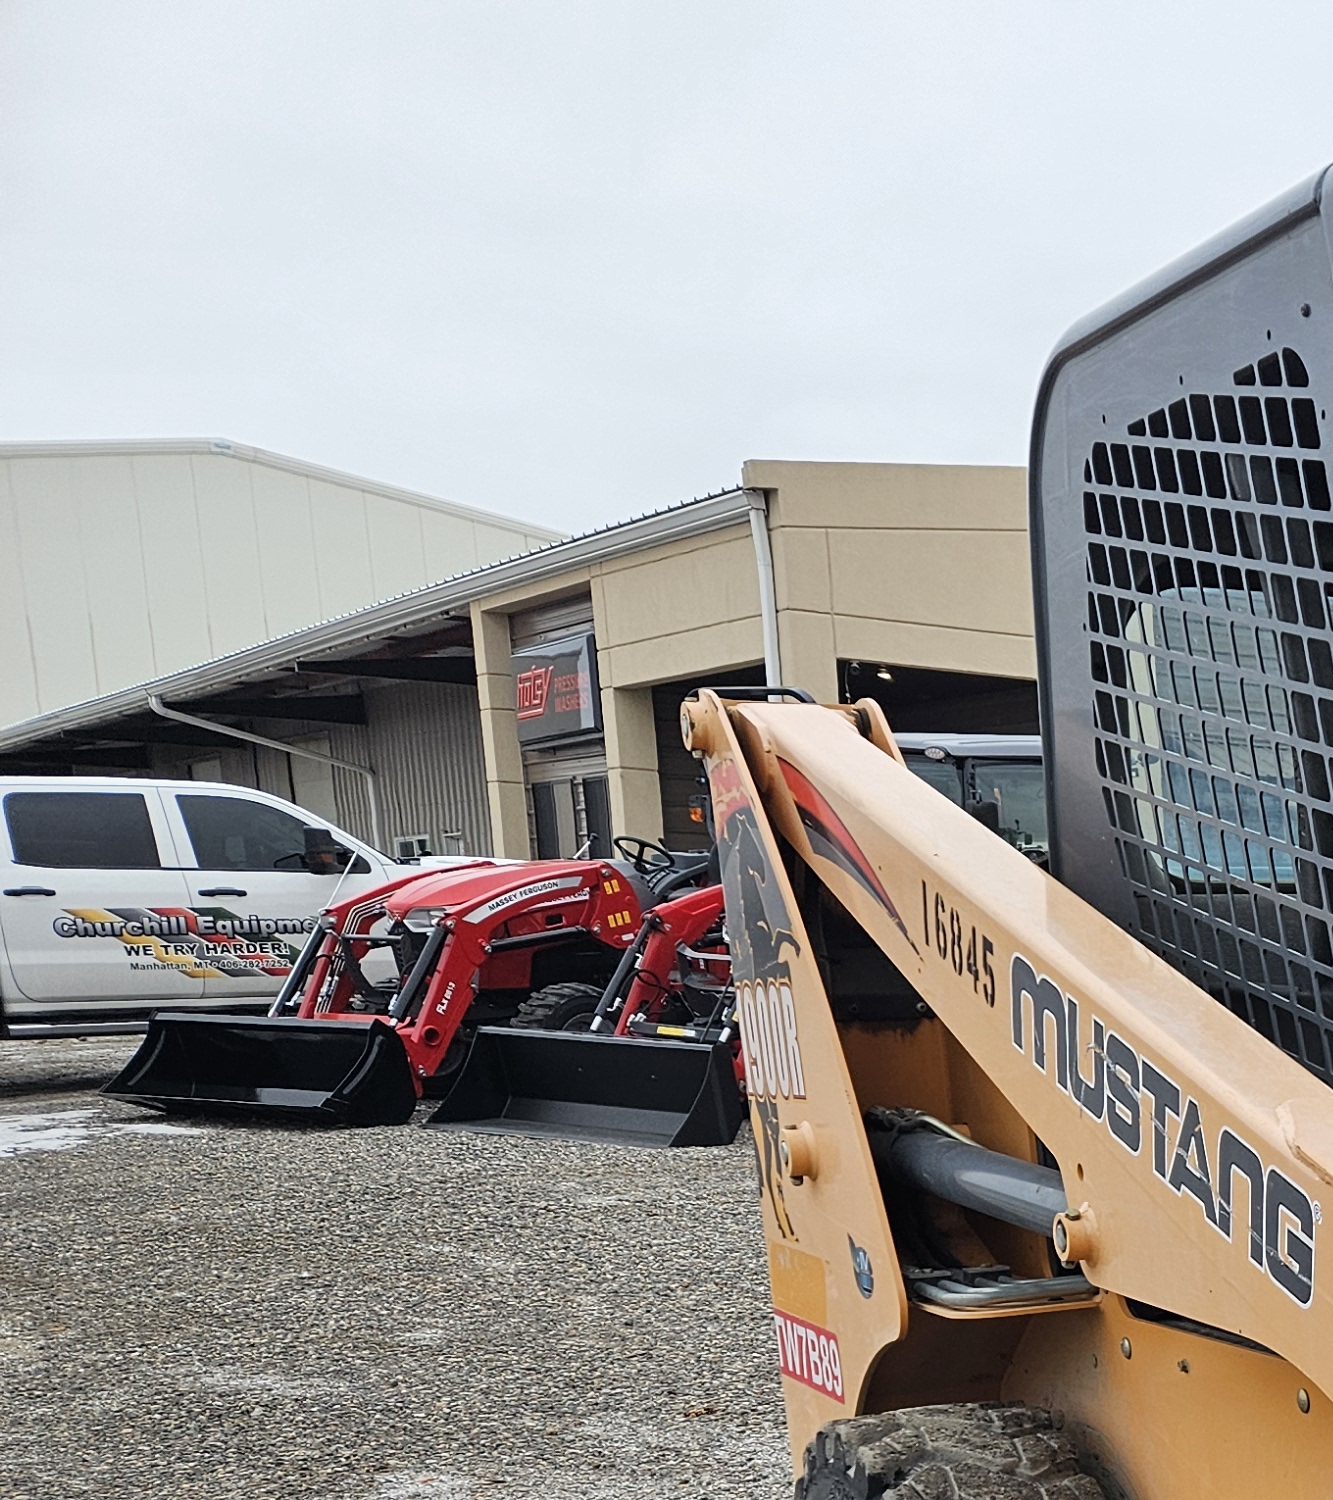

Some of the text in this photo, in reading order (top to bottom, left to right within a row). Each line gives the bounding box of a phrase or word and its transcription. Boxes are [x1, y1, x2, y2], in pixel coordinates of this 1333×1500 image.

[488, 893, 518, 912] MASSEY
[520, 881, 559, 897] FERGUSON
[53, 914, 316, 941] Churchill Equipme
[124, 942, 290, 957] WE TRY HARDER!
[922, 879, 996, 1008] 16845
[130, 961, 190, 971] Manhattan,
[1010, 952, 1315, 1309] MUSTANG
[774, 1314, 842, 1397] TW7B89
